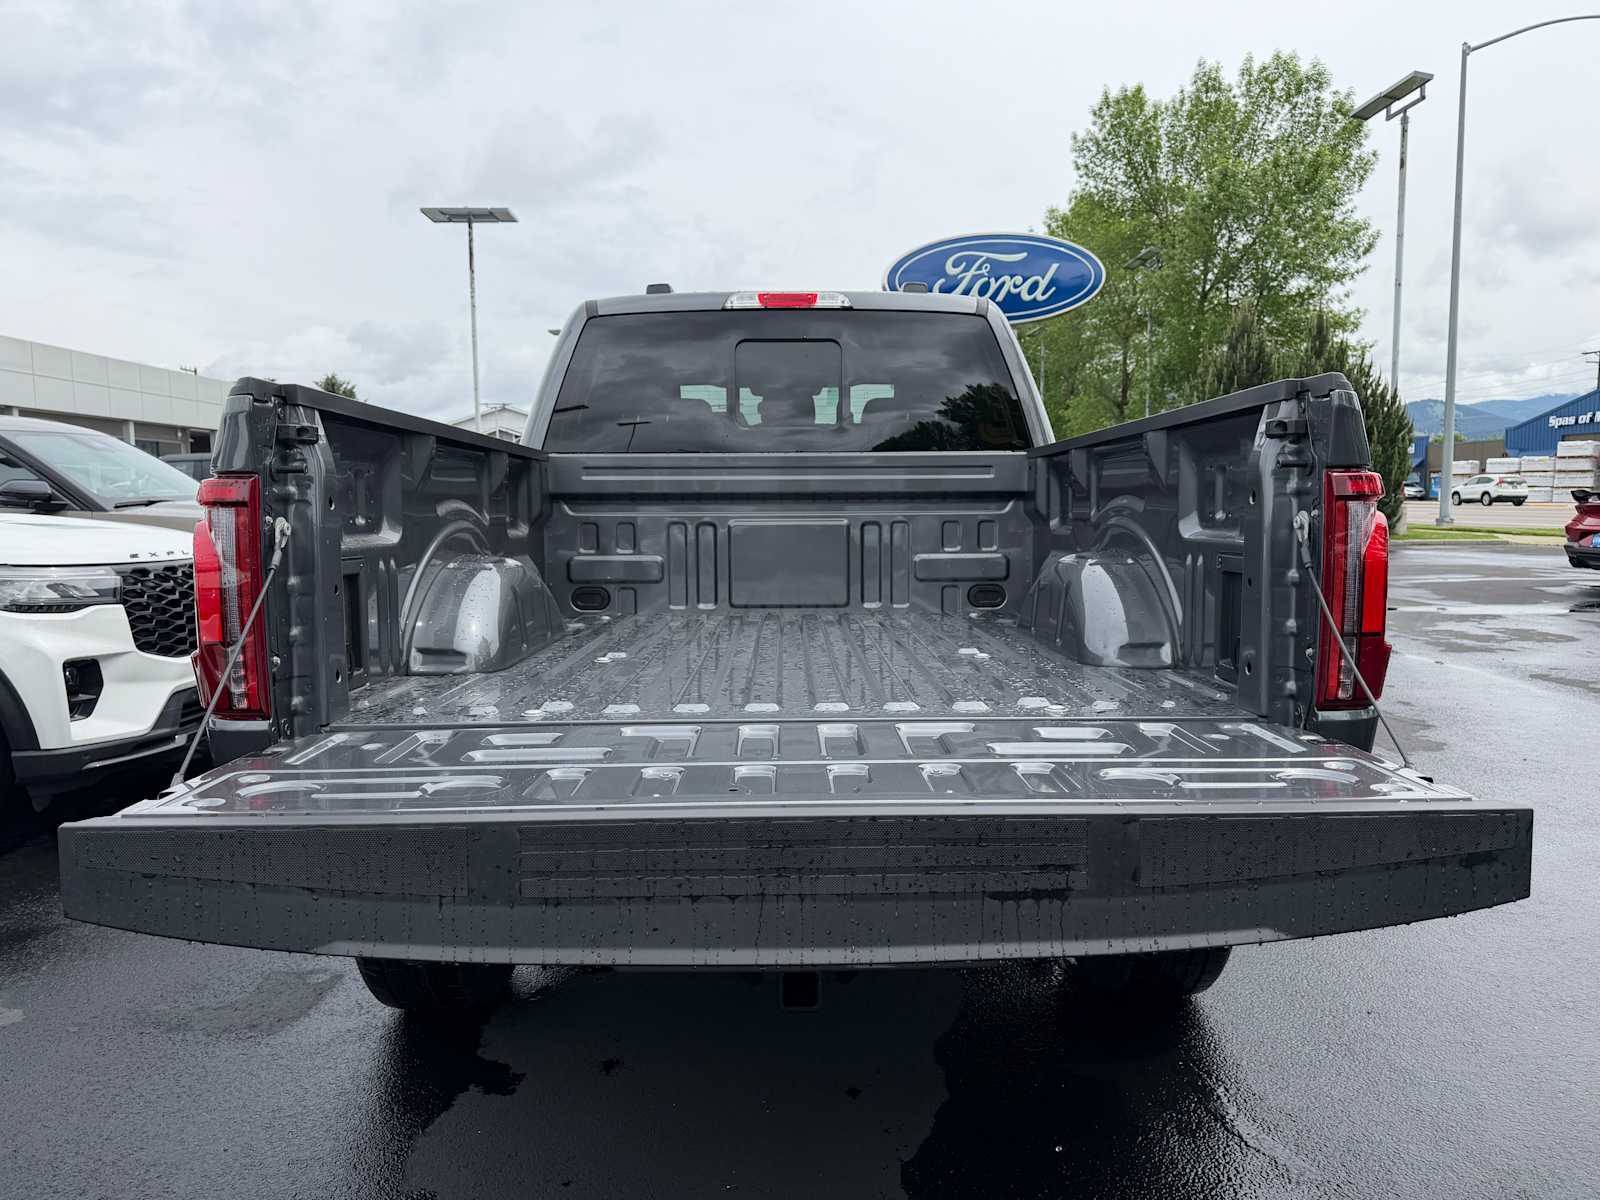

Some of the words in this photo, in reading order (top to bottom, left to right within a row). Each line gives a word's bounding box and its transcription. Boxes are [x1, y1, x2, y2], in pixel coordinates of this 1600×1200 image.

[932, 251, 1060, 302] Ford
[1548, 415, 1576, 429] Spas
[1578, 411, 1593, 424] of
